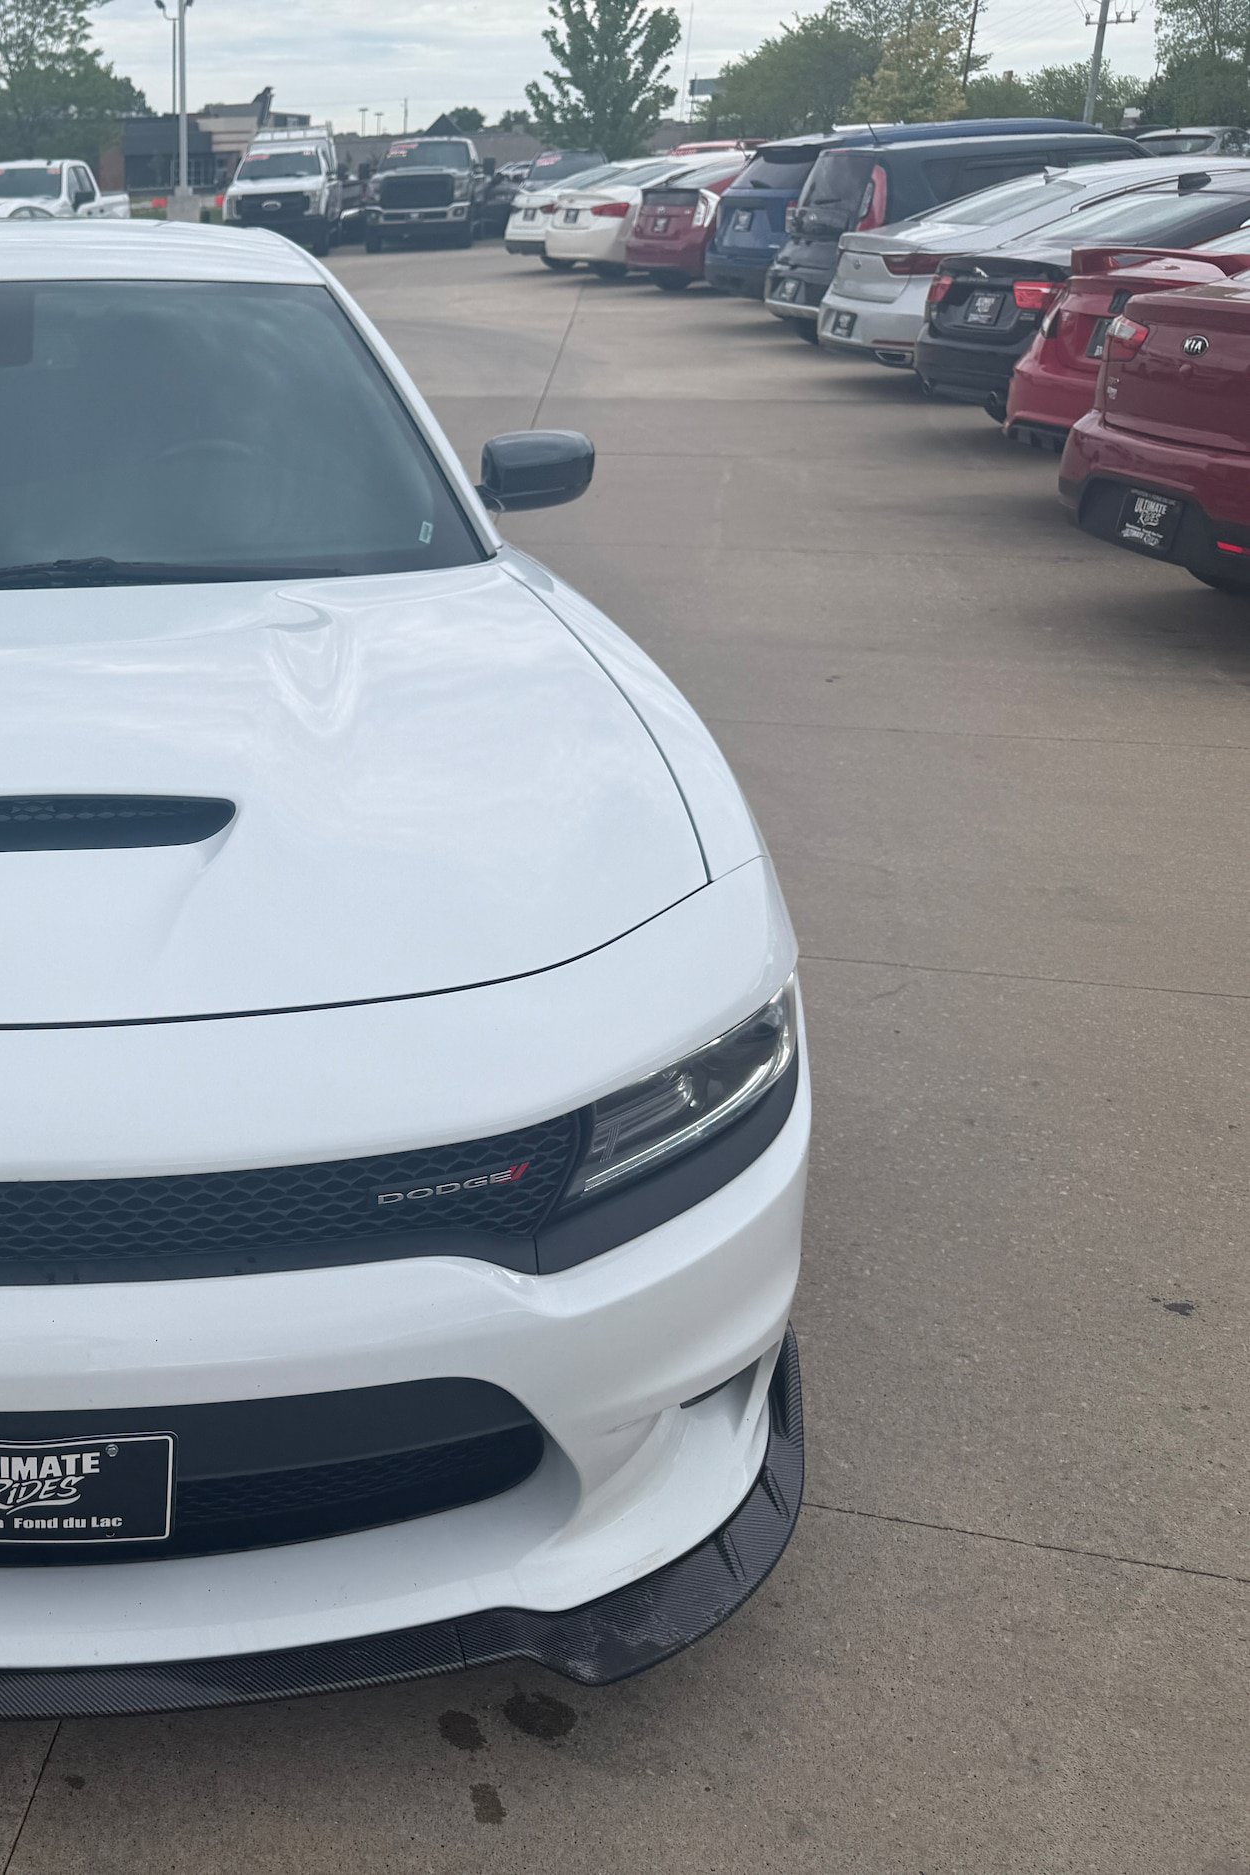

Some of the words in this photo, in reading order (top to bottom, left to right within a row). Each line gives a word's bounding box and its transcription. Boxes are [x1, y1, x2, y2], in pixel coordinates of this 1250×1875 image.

[1183, 338, 1203, 354] KIA
[377, 1169, 513, 1205] DODGE
[13, 1516, 59, 1529] Fond
[62, 1516, 87, 1528] du
[91, 1516, 123, 1528] Lac
